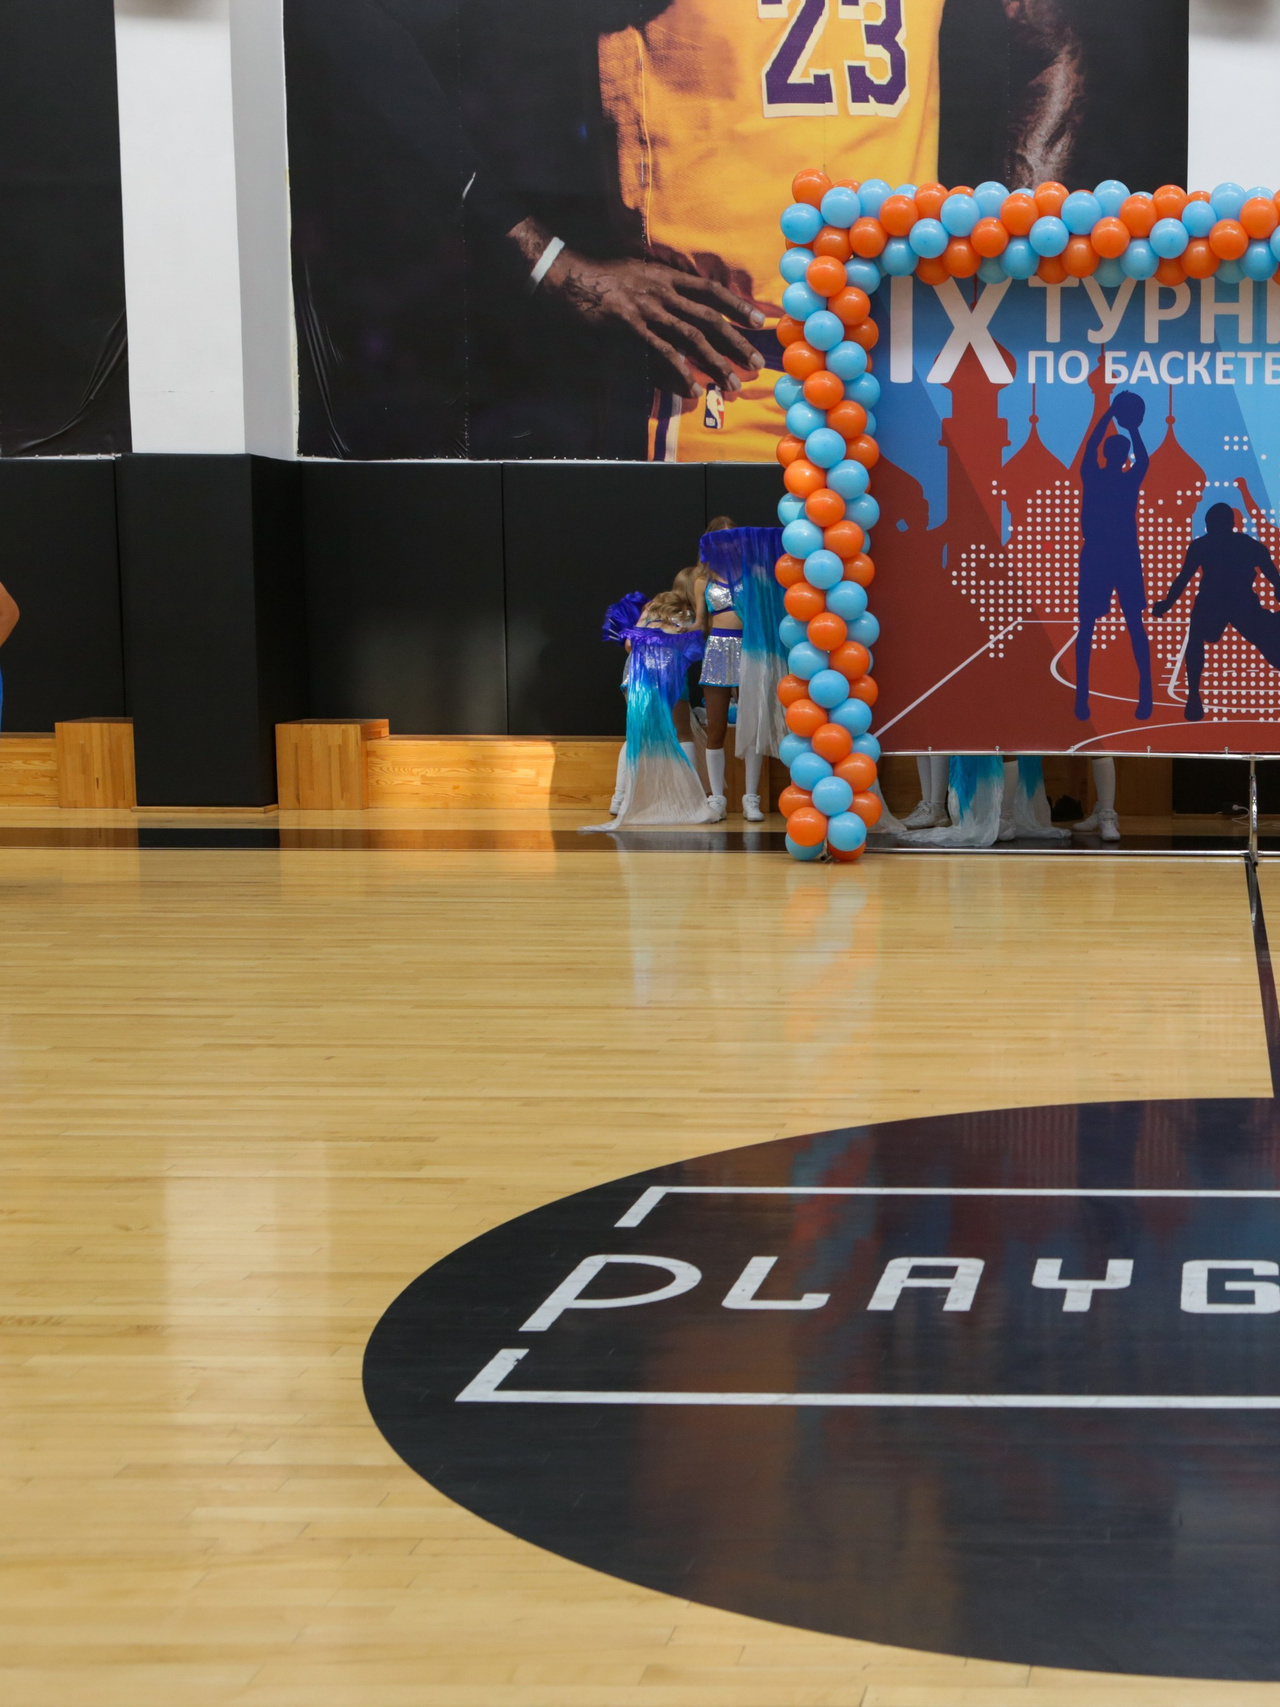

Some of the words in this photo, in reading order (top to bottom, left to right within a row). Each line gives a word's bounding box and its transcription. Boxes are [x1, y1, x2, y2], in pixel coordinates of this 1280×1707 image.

[757, 0, 910, 118] 23
[890, 275, 1014, 384] IX
[1028, 350, 1089, 384] ПО
